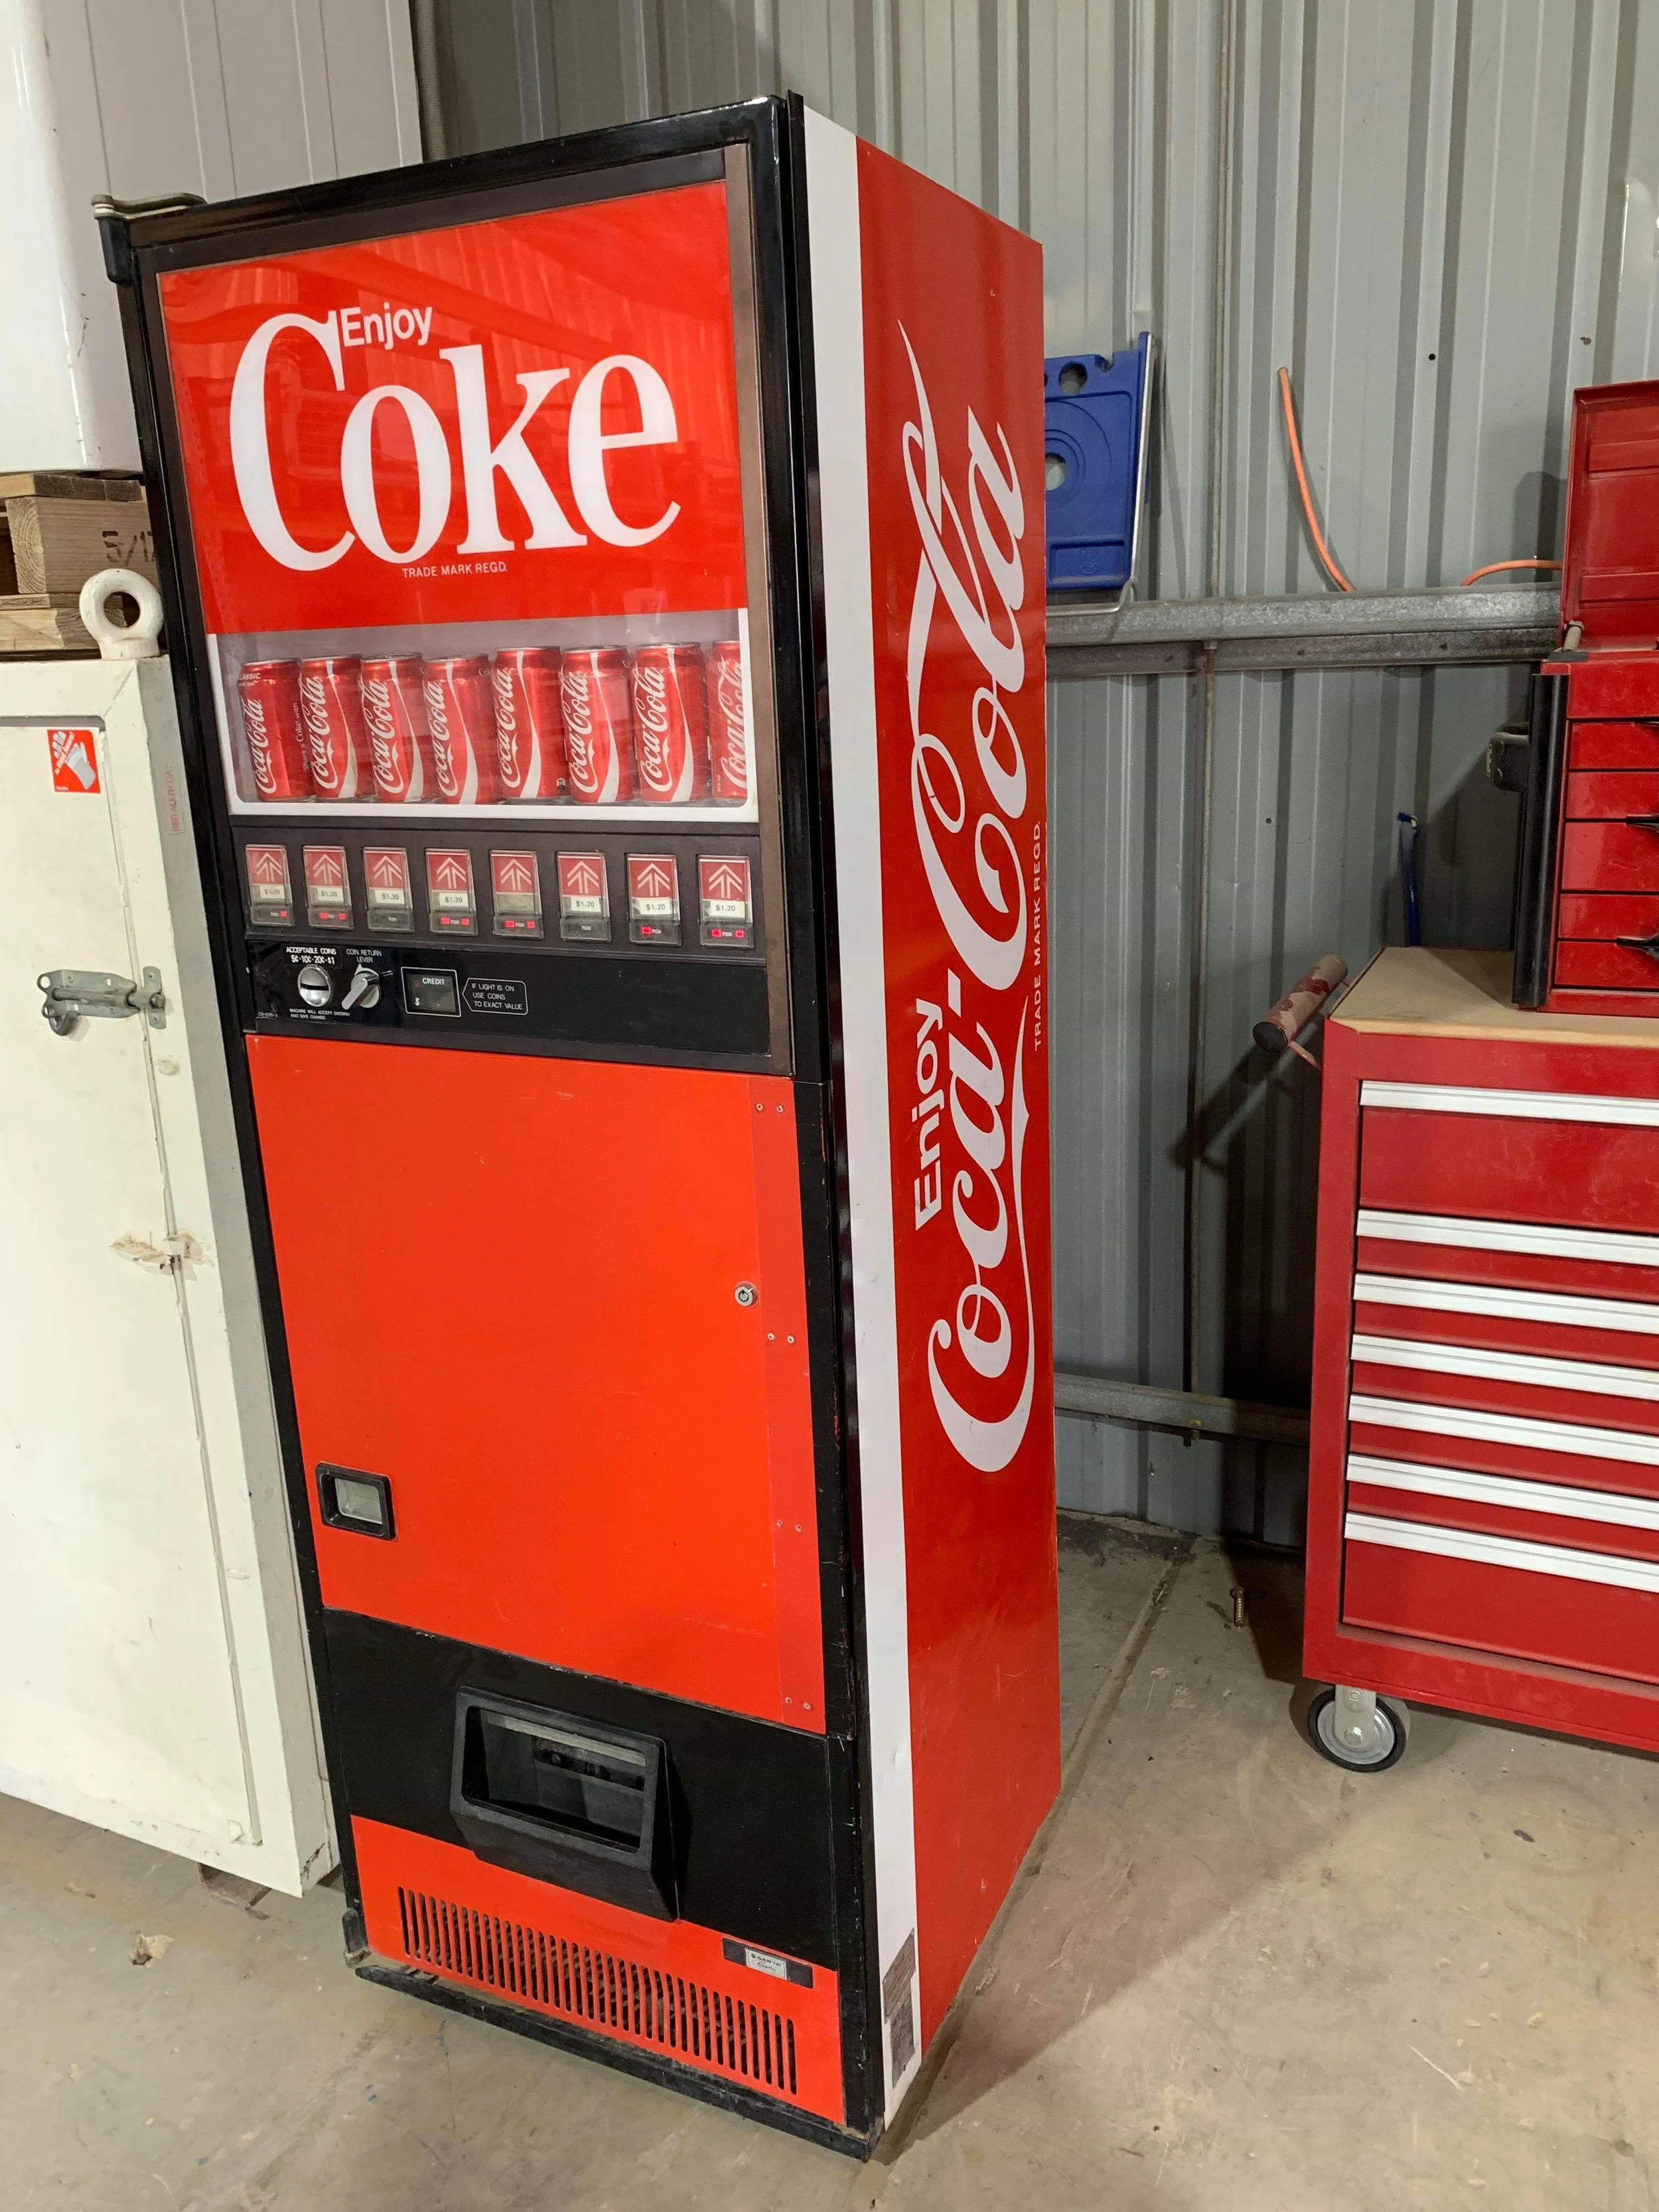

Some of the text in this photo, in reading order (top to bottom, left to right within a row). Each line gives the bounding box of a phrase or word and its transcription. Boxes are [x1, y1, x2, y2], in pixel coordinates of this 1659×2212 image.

[341, 302, 433, 350] Enjoy
[230, 309, 681, 571] Coke
[401, 566, 437, 578] TRADE
[441, 564, 473, 576] MARK
[240, 695, 277, 794] Coca-Cola
[295, 719, 304, 742] Coke
[298, 672, 339, 789] Coca-Cola
[358, 674, 404, 794] Coca-Cola
[421, 678, 459, 796] Coca-Cola
[491, 665, 521, 788] Coca-Cola
[559, 664, 598, 793] Coca-Cola
[632, 660, 673, 792] Coca-Cola
[898, 319, 1036, 1473] Coca-Cola
[422, 977, 445, 986] CREDIT
[911, 997, 945, 1232] Enjoy
